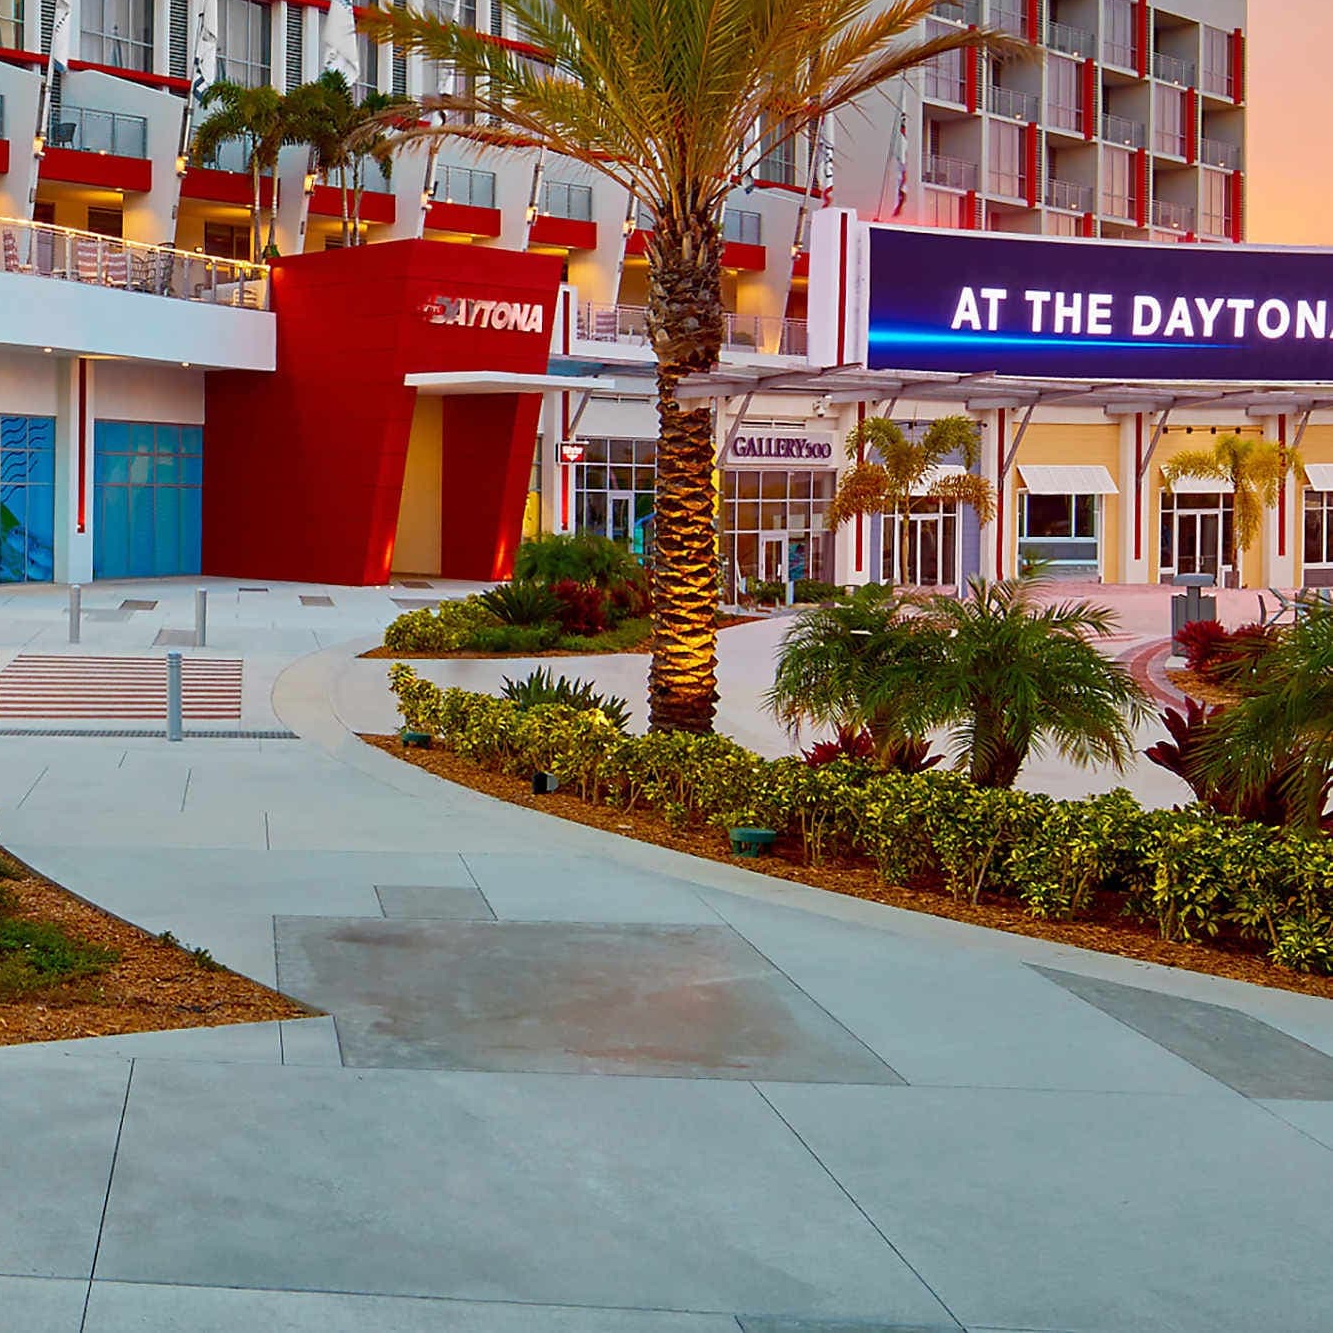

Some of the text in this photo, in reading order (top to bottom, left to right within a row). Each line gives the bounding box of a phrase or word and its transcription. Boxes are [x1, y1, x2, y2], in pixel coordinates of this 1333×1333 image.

[429, 296, 543, 333] DAYTONA
[950, 287, 1333, 339] AT THE DAYTON
